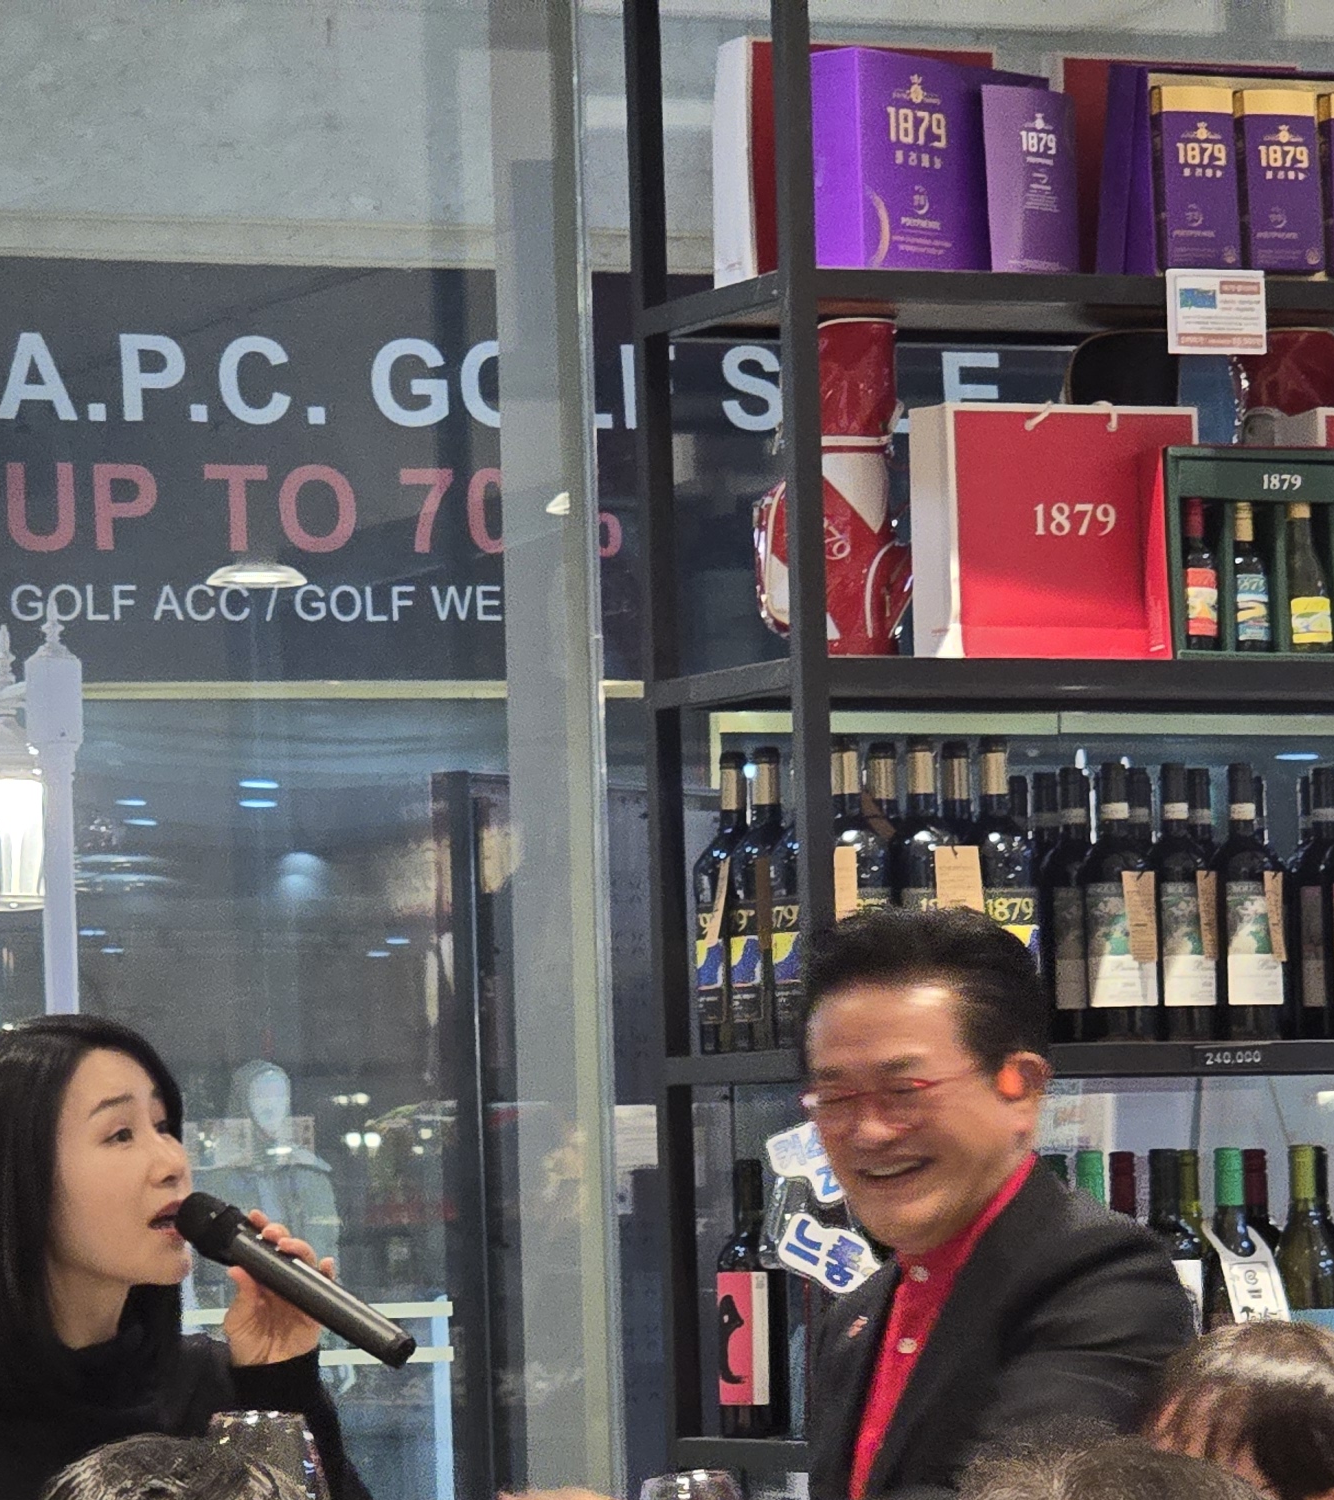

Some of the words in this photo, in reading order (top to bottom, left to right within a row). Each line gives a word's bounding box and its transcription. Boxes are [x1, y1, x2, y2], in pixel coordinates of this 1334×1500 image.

[886, 105, 947, 149] 1879
[1020, 130, 1057, 155] 1879
[1176, 142, 1227, 167] 1879
[1258, 145, 1309, 169] 1879
[1263, 473, 1303, 491] 1879
[4, 461, 158, 554] UP
[203, 462, 358, 554] TO
[1033, 502, 1118, 538] 1879
[9, 583, 137, 623] GOLF
[153, 584, 253, 623] ACC
[294, 584, 415, 623] GOLF
[433, 584, 503, 623] WE
[986, 896, 1035, 922] 1879
